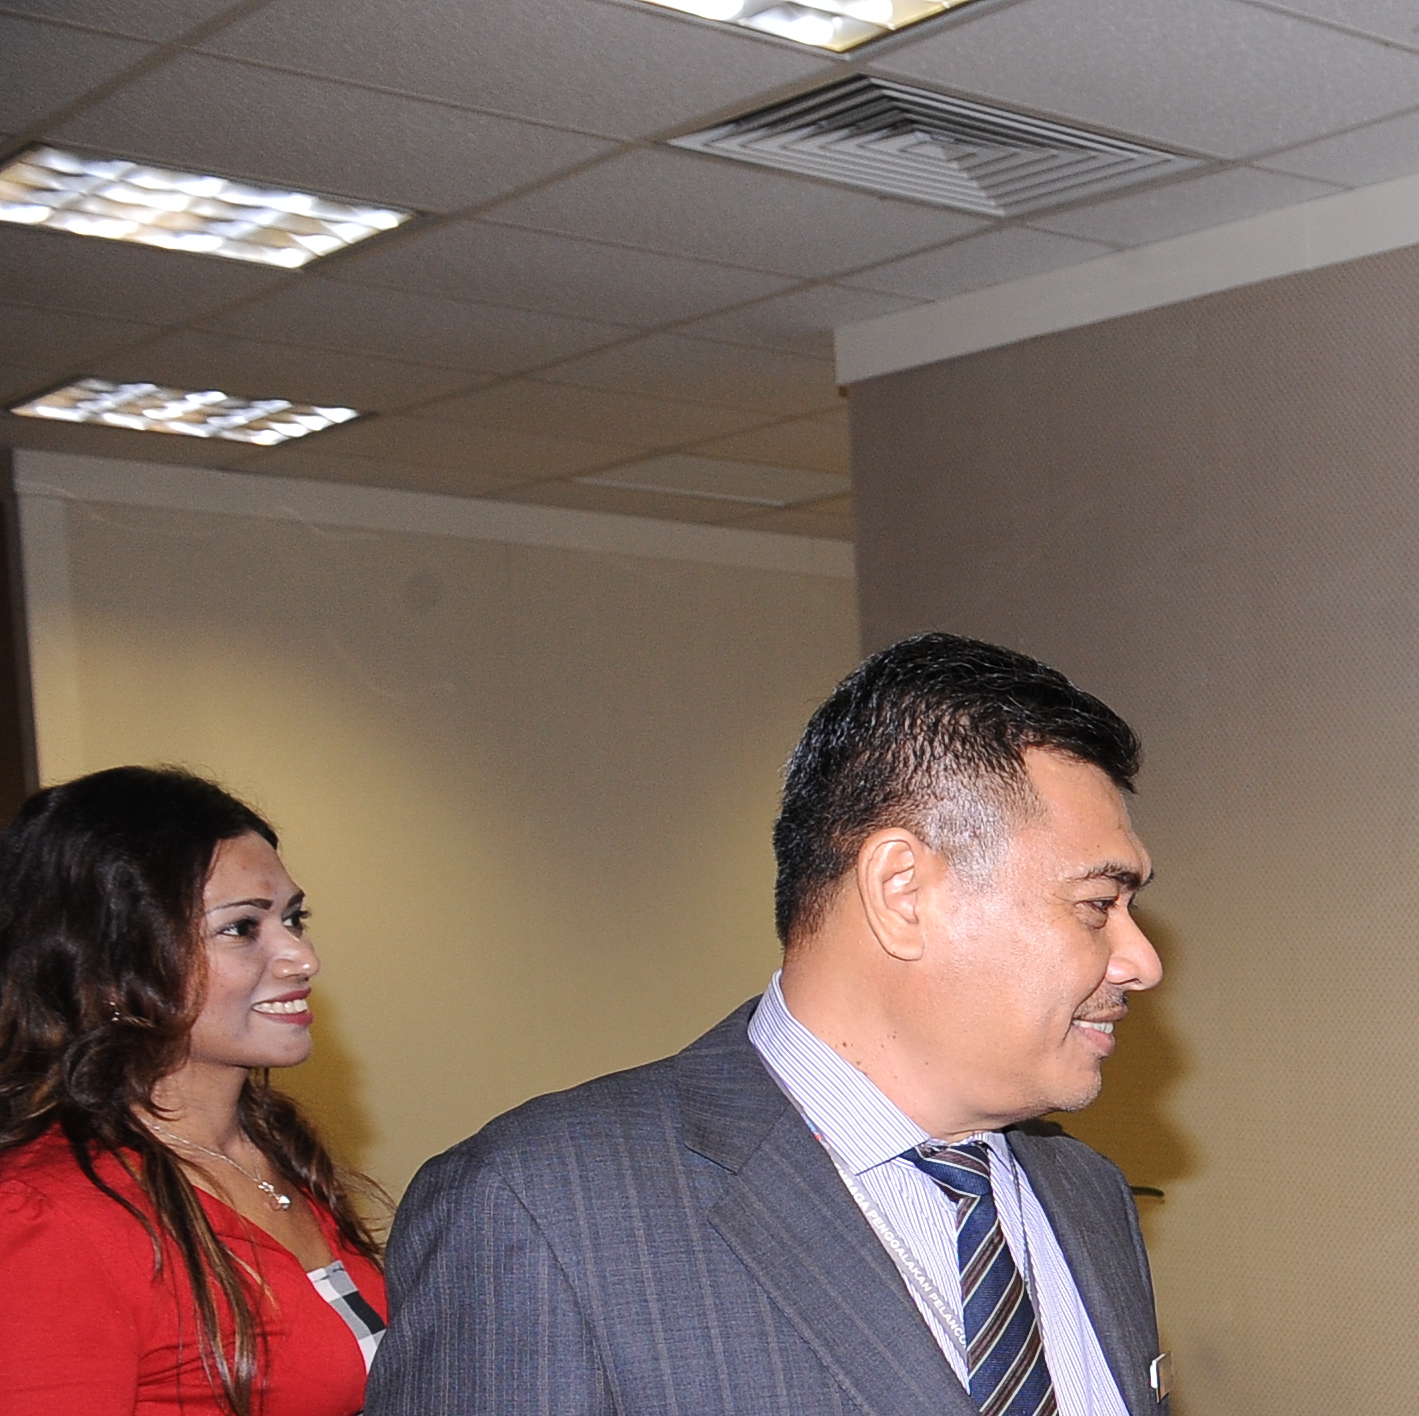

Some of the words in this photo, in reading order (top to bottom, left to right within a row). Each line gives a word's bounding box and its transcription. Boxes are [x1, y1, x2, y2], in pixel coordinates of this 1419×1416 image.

[833, 1162, 871, 1212] MBAGA
[866, 1209, 932, 1292] PENGGALAKAN
[928, 1292, 967, 1348] PELANCO
